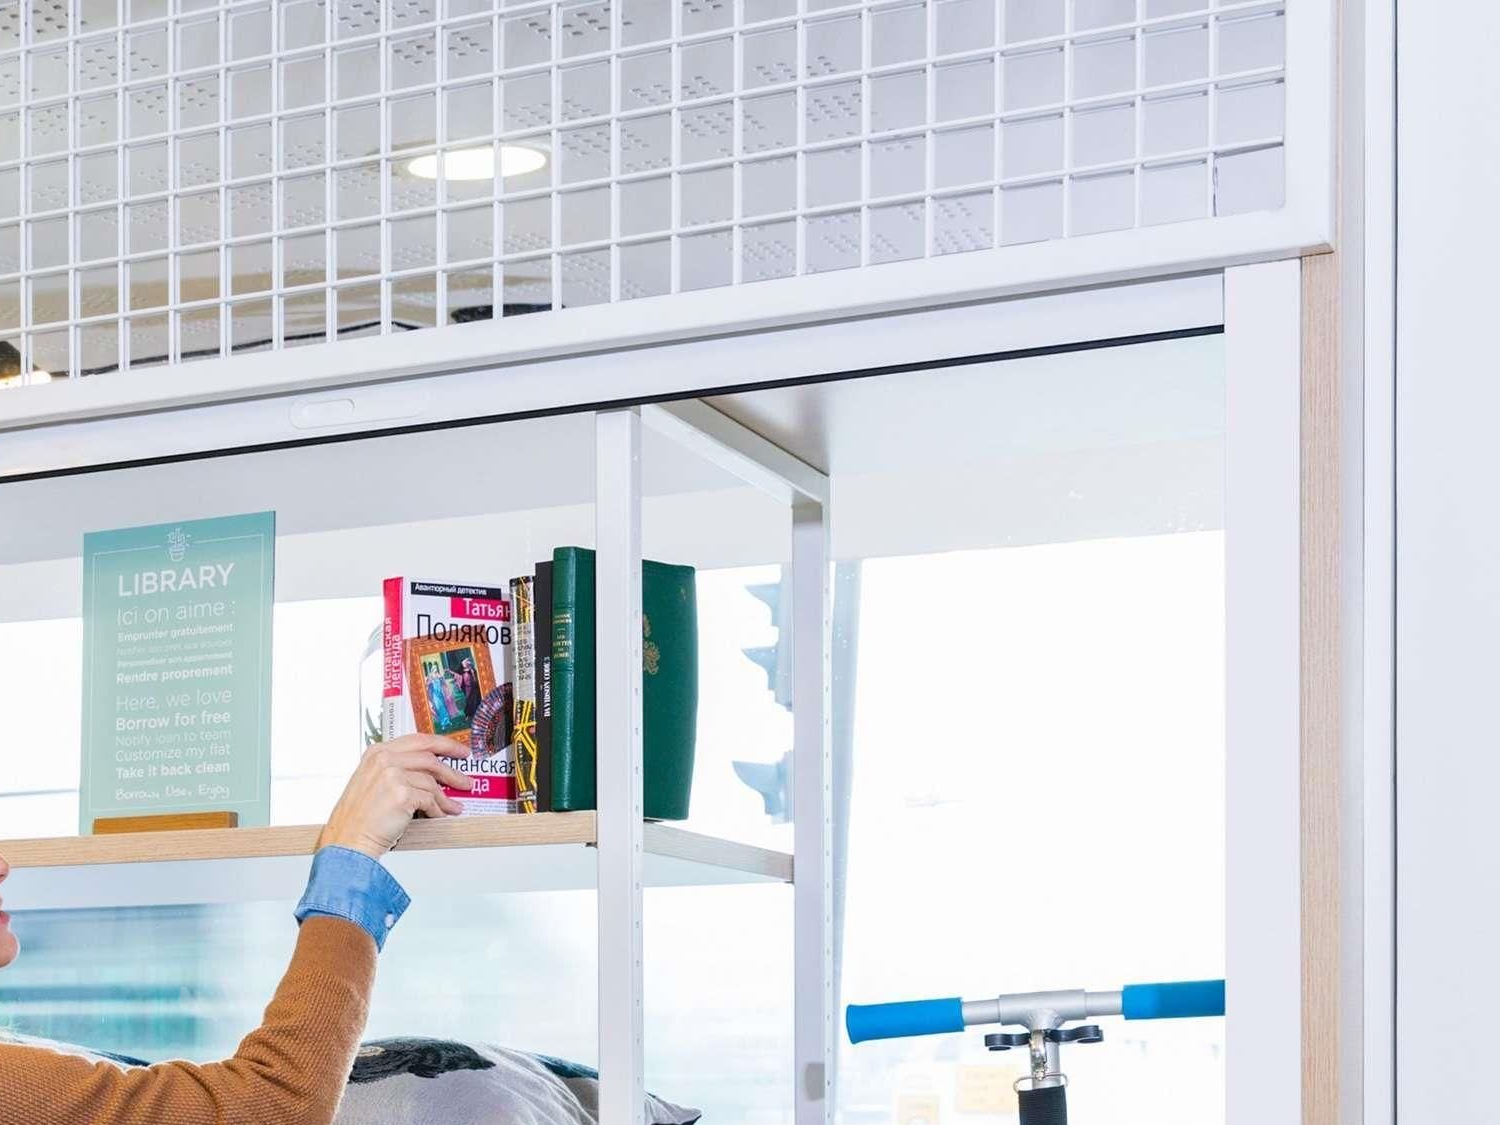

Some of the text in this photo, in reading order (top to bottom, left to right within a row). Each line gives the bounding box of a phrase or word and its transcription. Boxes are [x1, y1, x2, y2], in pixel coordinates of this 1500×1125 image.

[118, 562, 235, 597] LIBRARY
[414, 584, 487, 596] Авантюрный детектив
[117, 605, 139, 626] Ici
[144, 607, 170, 623] on
[175, 600, 225, 620] aime
[117, 623, 234, 642] Emprunter gratuitement
[383, 617, 392, 689] Испанская
[391, 634, 402, 689] легенда
[116, 664, 233, 684] Rendre proprement
[165, 693, 191, 707] we
[197, 688, 232, 705] love
[116, 710, 231, 731] Borrow for free
[200, 728, 231, 741] team
[116, 748, 182, 762] Customize
[186, 746, 206, 758] my
[116, 760, 230, 780] Take it back clean
